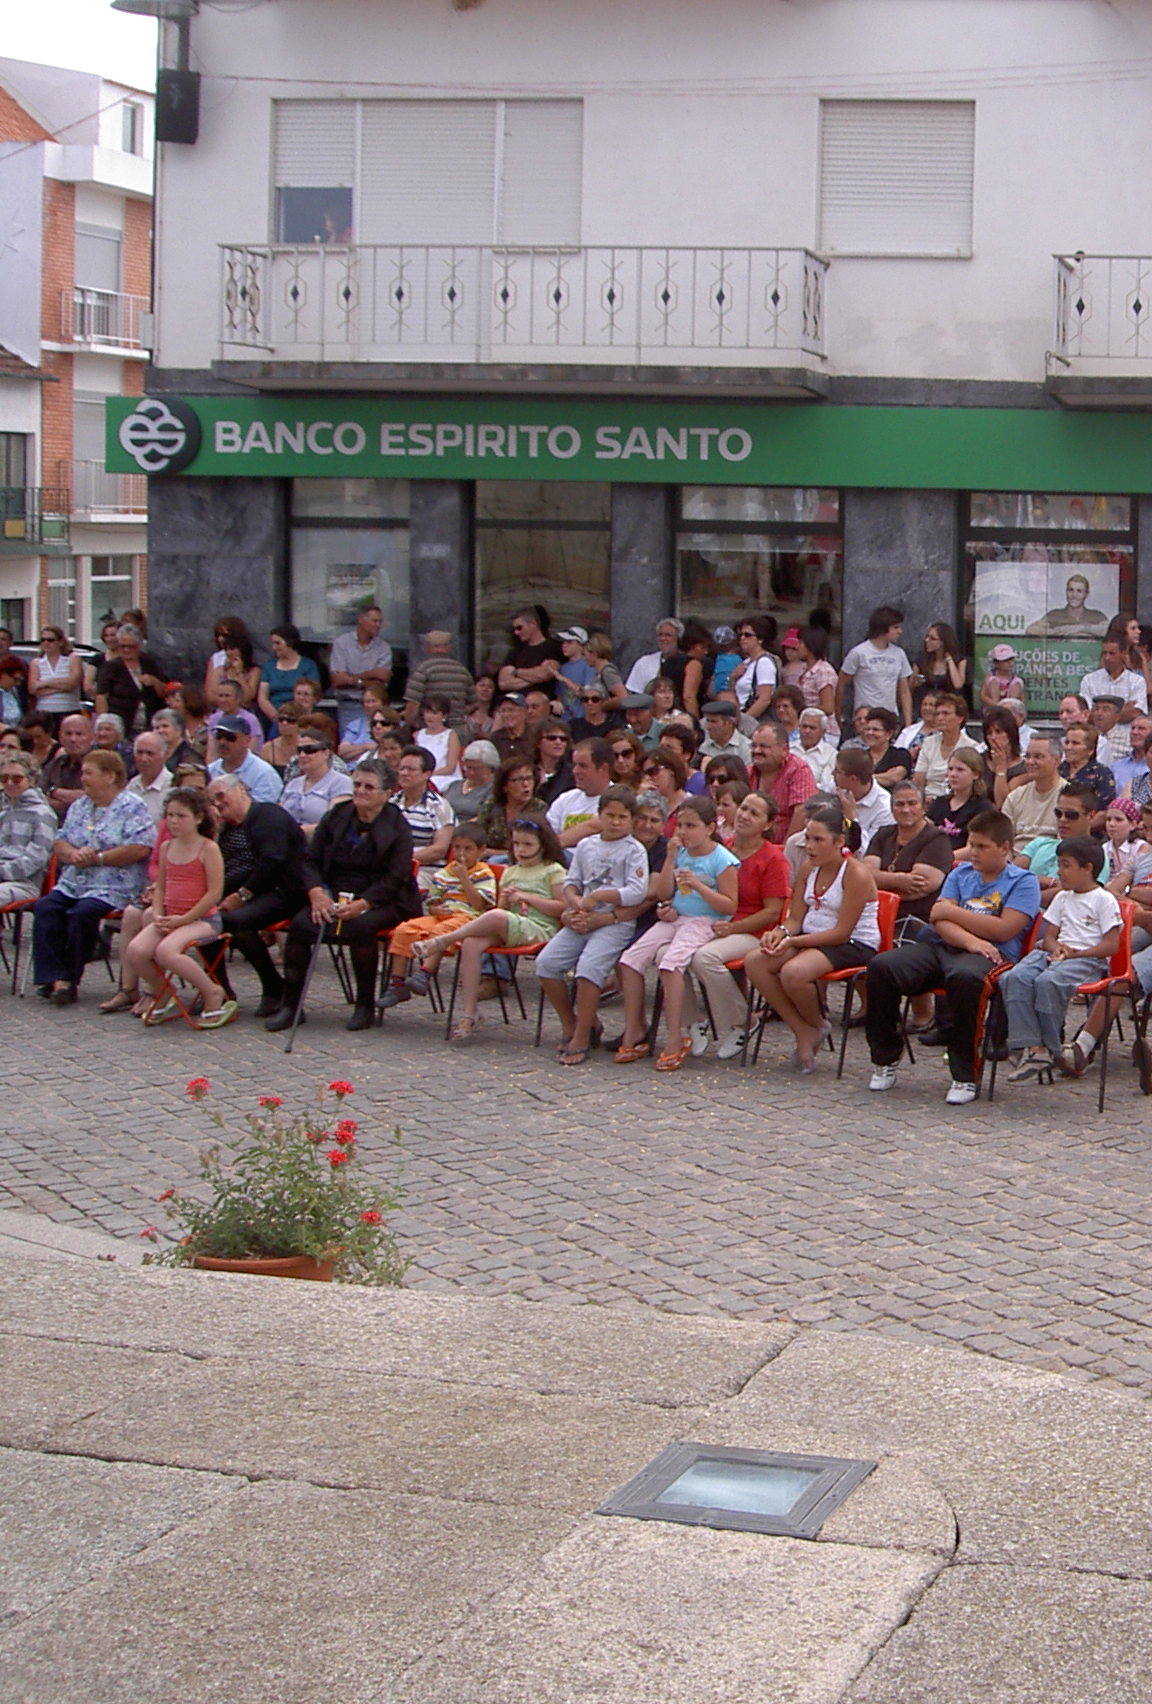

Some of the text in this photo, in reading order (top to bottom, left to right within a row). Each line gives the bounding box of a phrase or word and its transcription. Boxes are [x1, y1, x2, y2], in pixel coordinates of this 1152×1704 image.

[214, 421, 753, 462] BANCO ESPIRITO SANTO
[979, 614, 1025, 630] AQUI
[1015, 648, 1080, 664] UÇÕES DE
[1015, 664, 1062, 678] PANÇA
